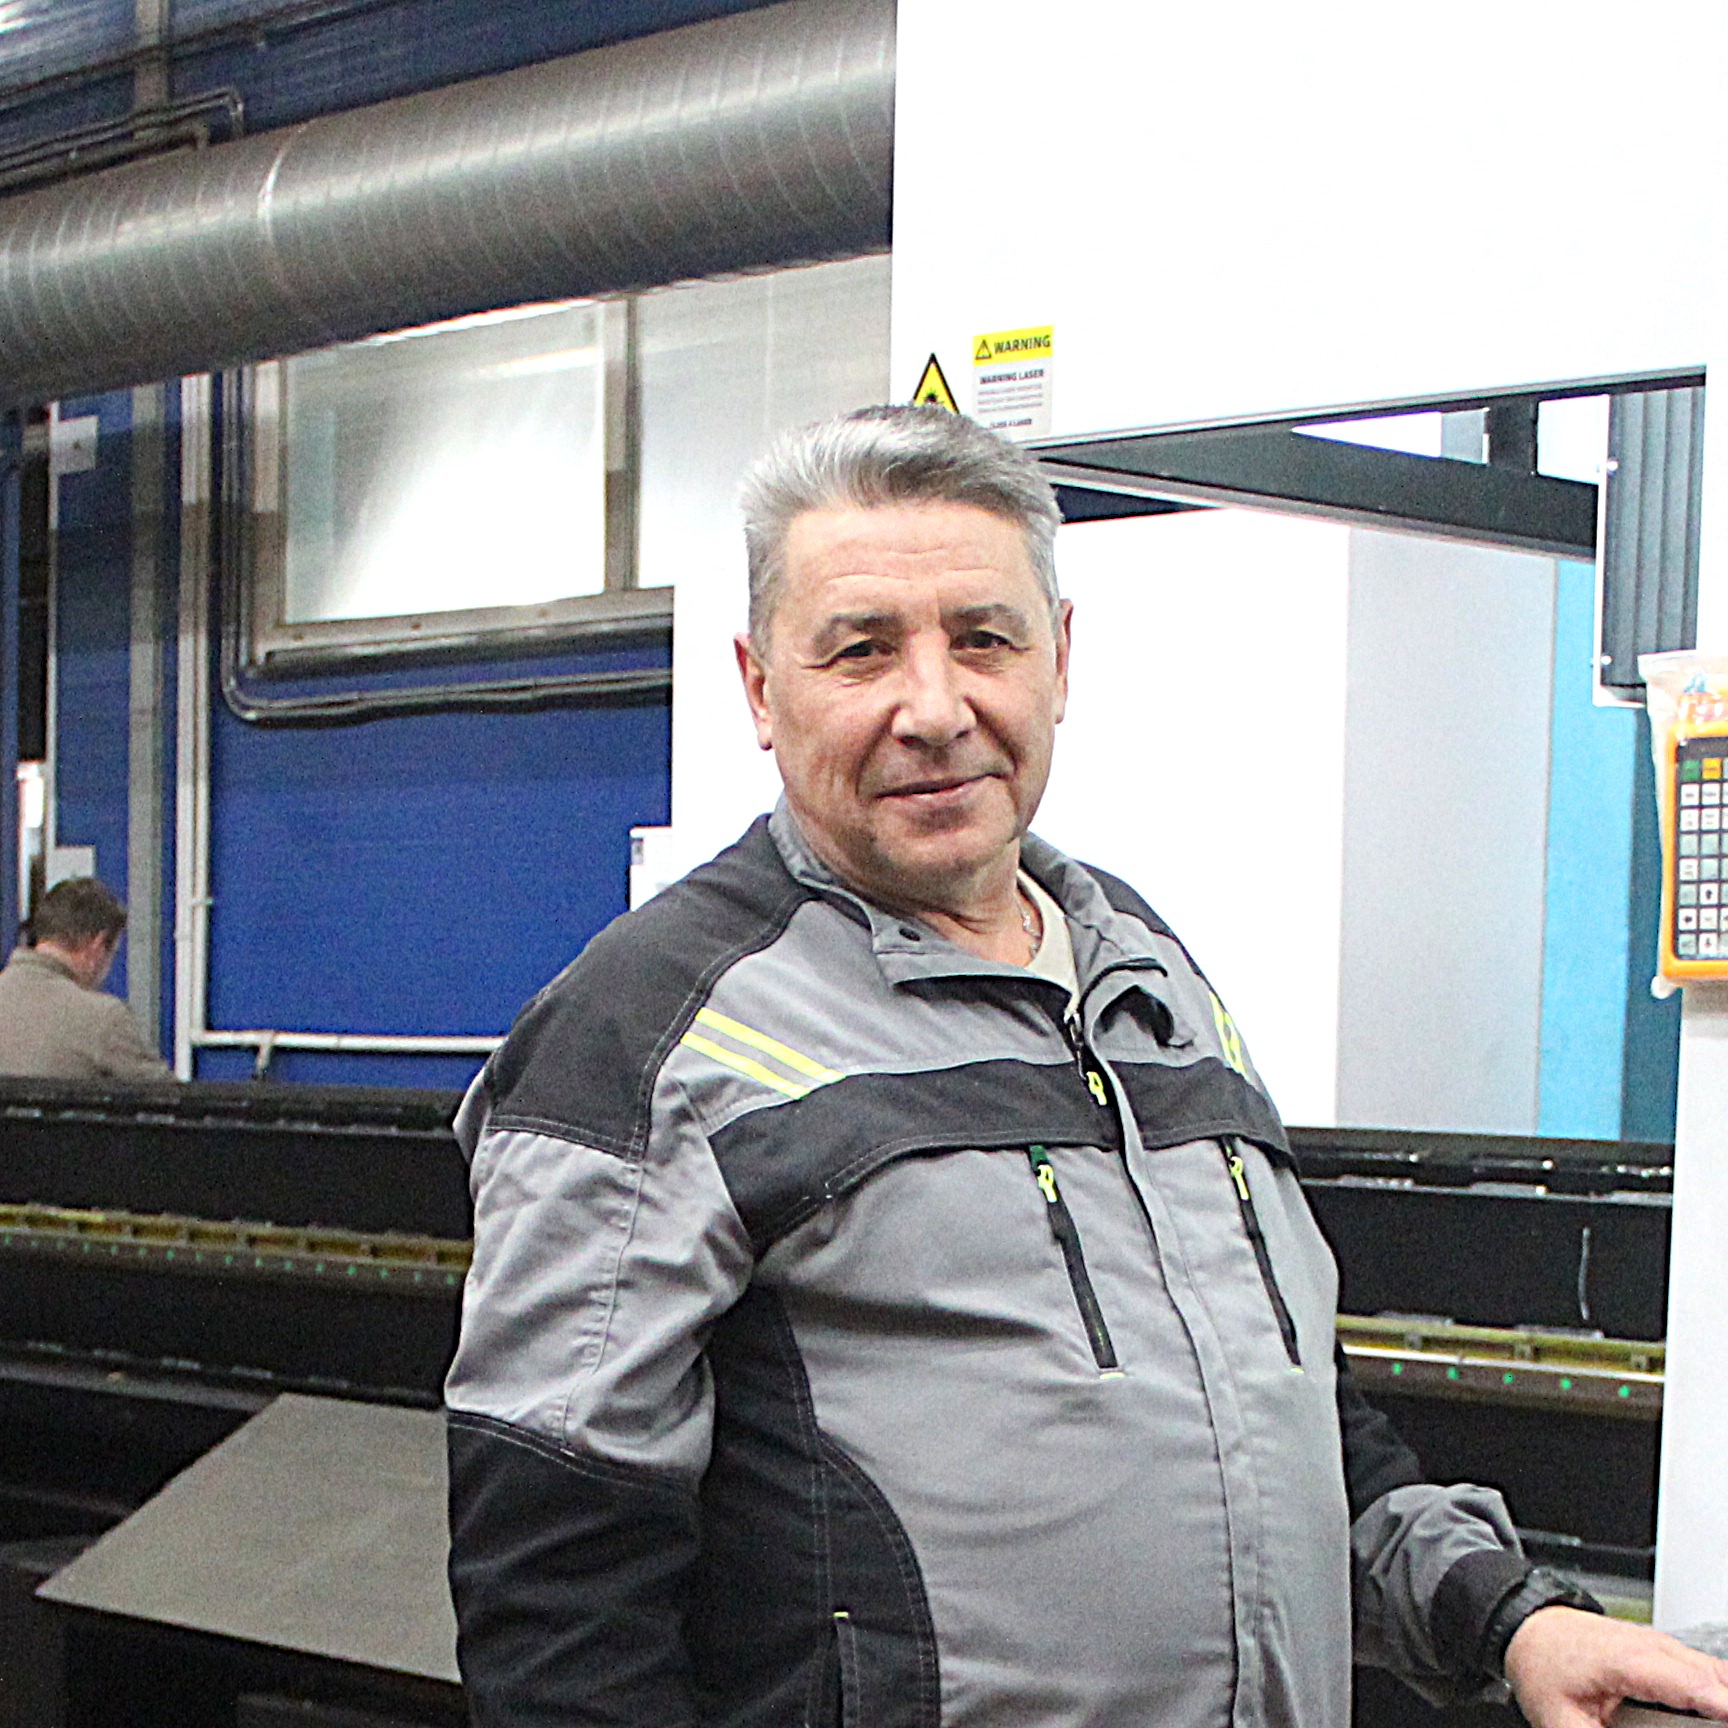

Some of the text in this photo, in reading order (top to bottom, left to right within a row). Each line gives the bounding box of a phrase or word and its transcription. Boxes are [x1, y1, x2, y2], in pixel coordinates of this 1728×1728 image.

[994, 335, 1051, 354] WARNING
[980, 369, 1045, 384] WARNING LASER
